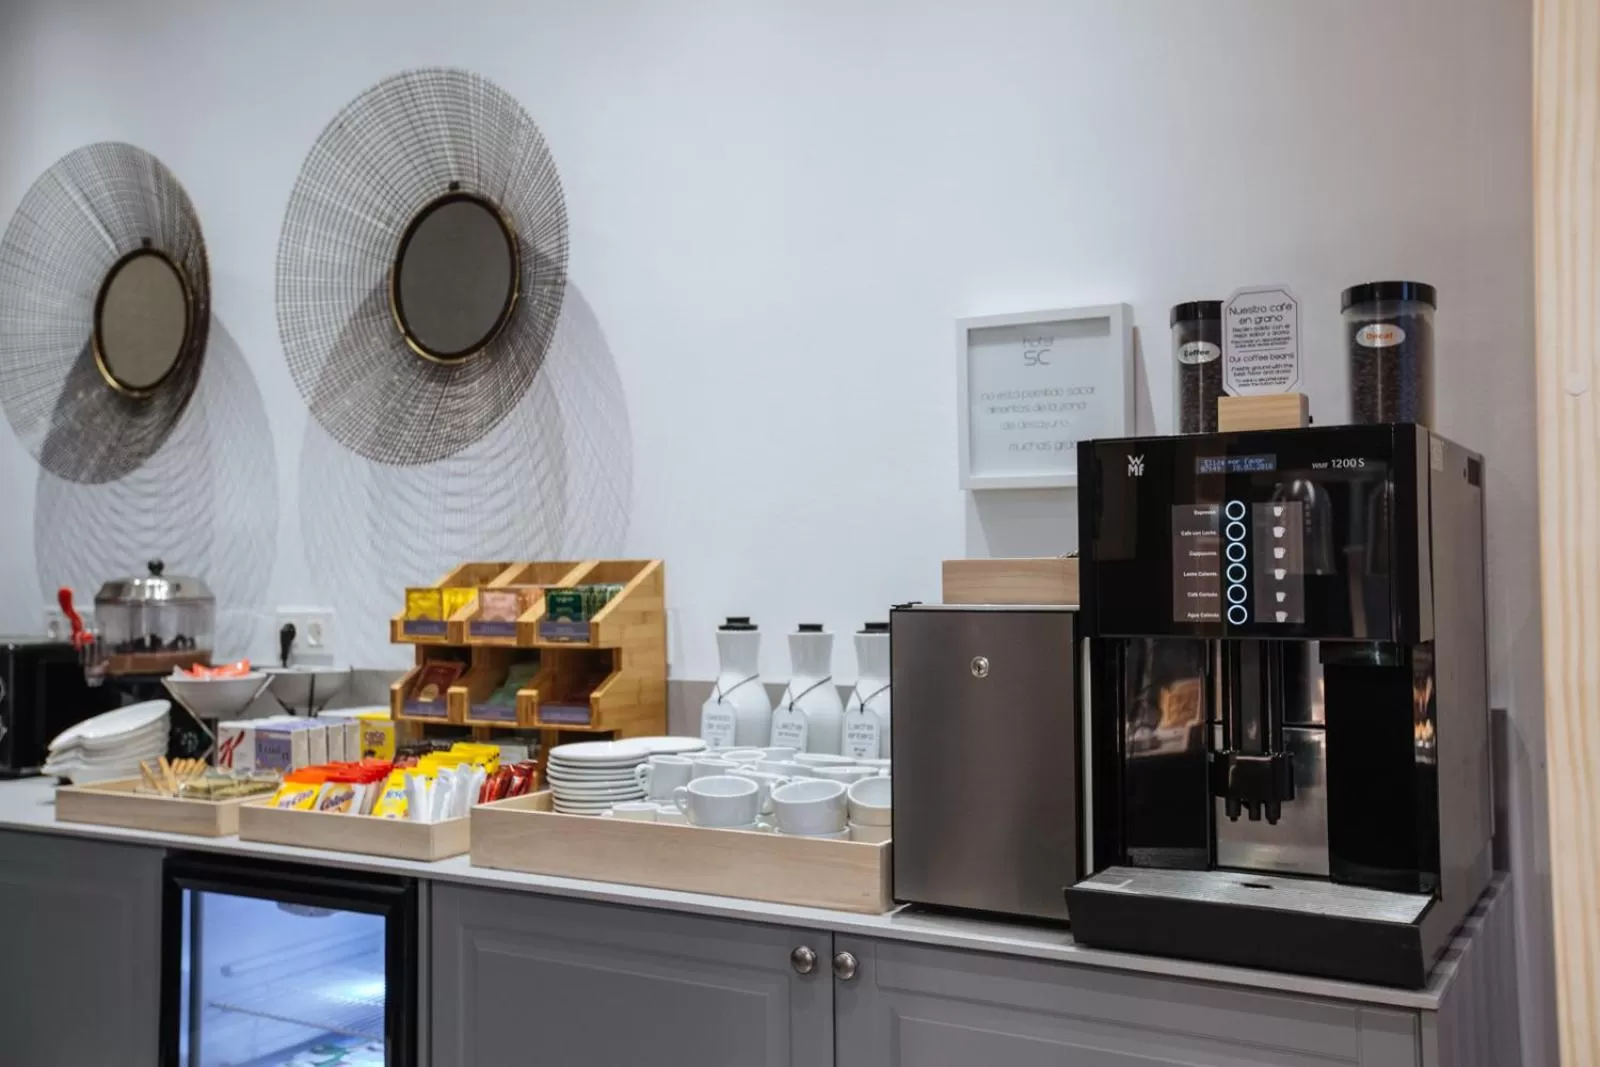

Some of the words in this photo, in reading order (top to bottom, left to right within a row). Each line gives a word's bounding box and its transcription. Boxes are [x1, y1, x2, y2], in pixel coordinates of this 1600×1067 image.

[1229, 305, 1267, 316] Nuestro
[1239, 316, 1252, 325] en
[1254, 314, 1283, 325] grano
[1366, 331, 1393, 341] Decaf
[1024, 348, 1051, 367] SC
[1184, 348, 1210, 357] Coffee
[1229, 355, 1241, 363] Our
[1243, 353, 1268, 362] coffee
[1270, 351, 1294, 361] beans
[1066, 385, 1096, 397] sacar
[1127, 454, 1145, 477] WMF
[1331, 458, 1357, 469] 1200
[1358, 458, 1366, 469] S
[848, 722, 874, 732] Leche
